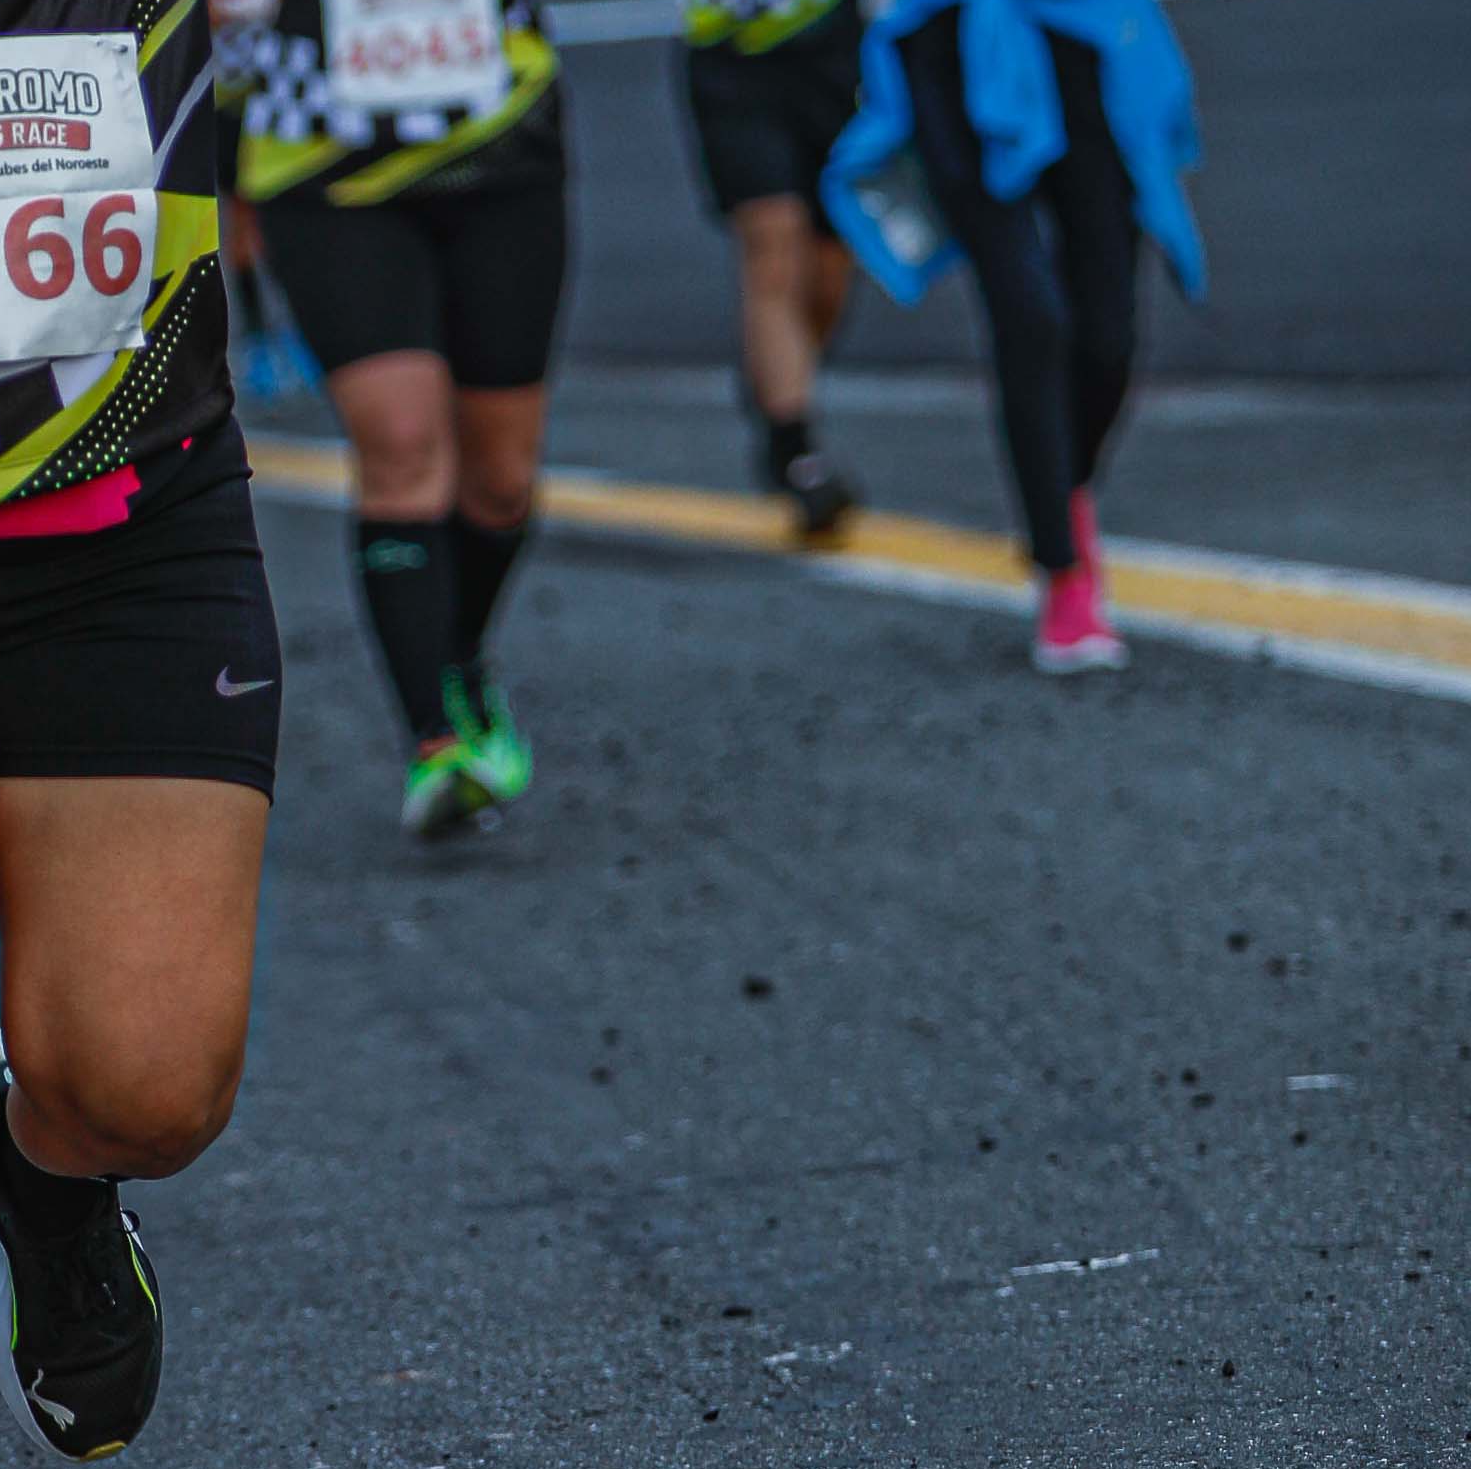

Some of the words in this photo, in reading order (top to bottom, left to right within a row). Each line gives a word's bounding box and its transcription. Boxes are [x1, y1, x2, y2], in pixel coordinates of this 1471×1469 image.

[12, 121, 69, 147] RACE
[31, 158, 53, 173] del
[55, 156, 110, 172] Noroeste
